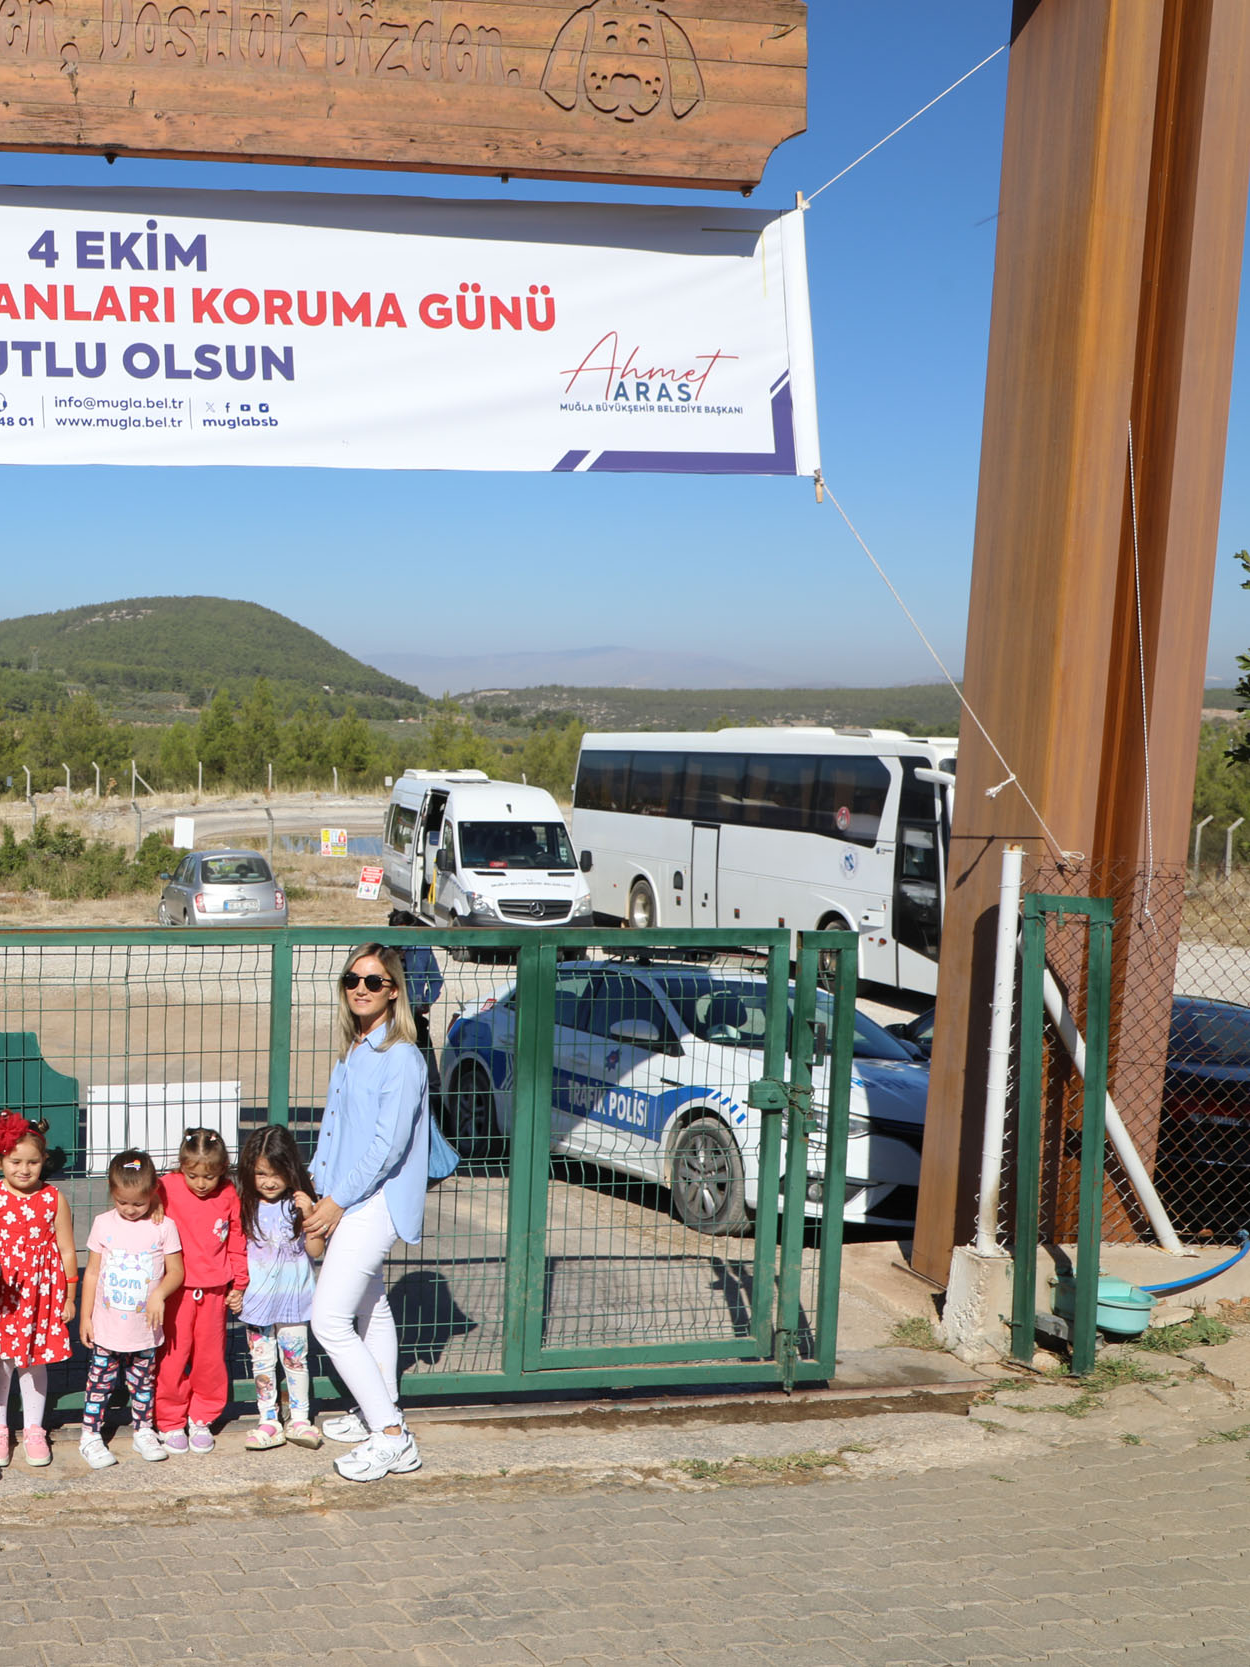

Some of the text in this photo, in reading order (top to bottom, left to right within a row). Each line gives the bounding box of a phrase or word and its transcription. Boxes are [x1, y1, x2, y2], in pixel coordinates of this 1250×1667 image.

[27, 218, 207, 272] 4 EKİM
[192, 287, 407, 329] KORUMA
[418, 282, 556, 332] GÜNÜ
[122, 342, 295, 382] OLSUN
[560, 331, 739, 400] Ahmet
[614, 381, 692, 402] ARAS
[54, 396, 184, 411] info@mugla.bel.tr
[560, 402, 743, 416] MUĞLA BÜYÜKŞEHİR BELEDİYE BAŞKANI
[19, 416, 35, 427] 01
[55, 416, 183, 430] www.mugla.bel.tr
[203, 416, 279, 430] muglabsb
